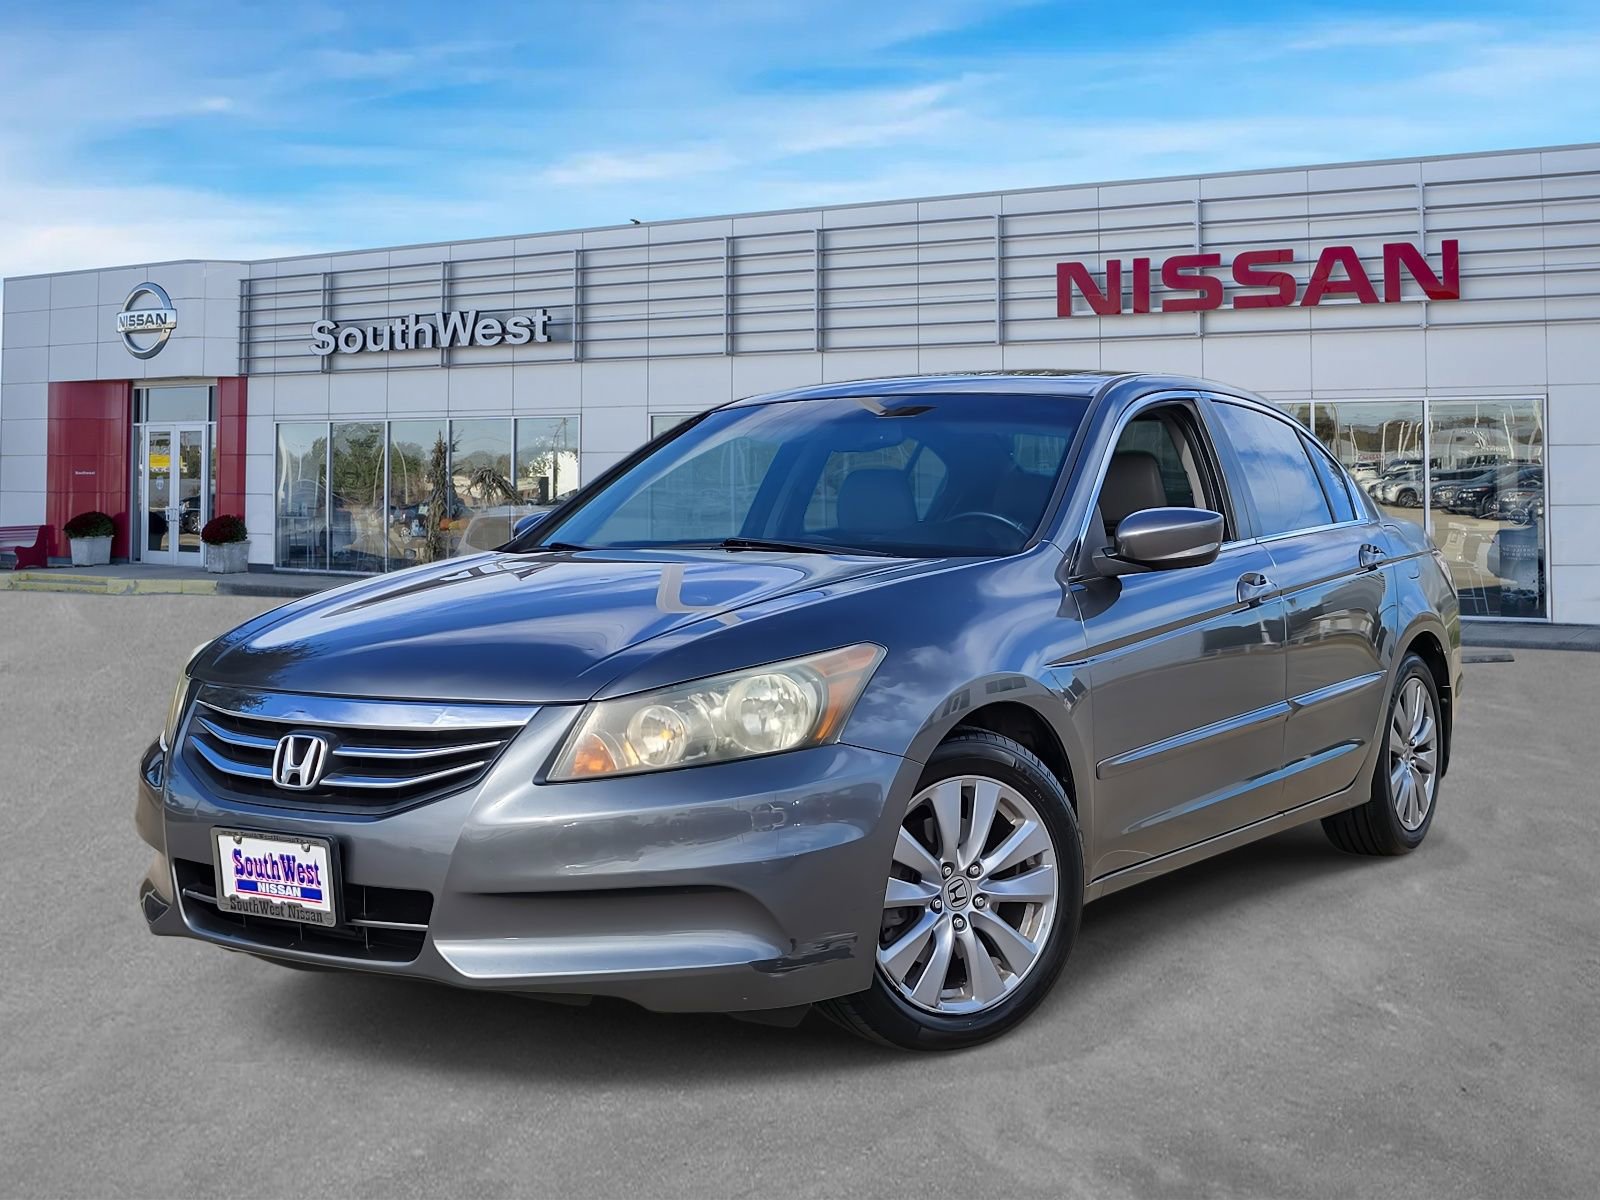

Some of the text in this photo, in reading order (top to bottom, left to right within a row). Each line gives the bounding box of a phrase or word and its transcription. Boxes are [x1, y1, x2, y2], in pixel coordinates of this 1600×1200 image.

[1057, 239, 1461, 317] NISSAN
[119, 313, 167, 328] NISSAN
[309, 308, 551, 356] SouthWest
[232, 848, 321, 887] SouthWest
[257, 881, 301, 897] NISSAN
[229, 894, 323, 923] SouthWest Nissan
